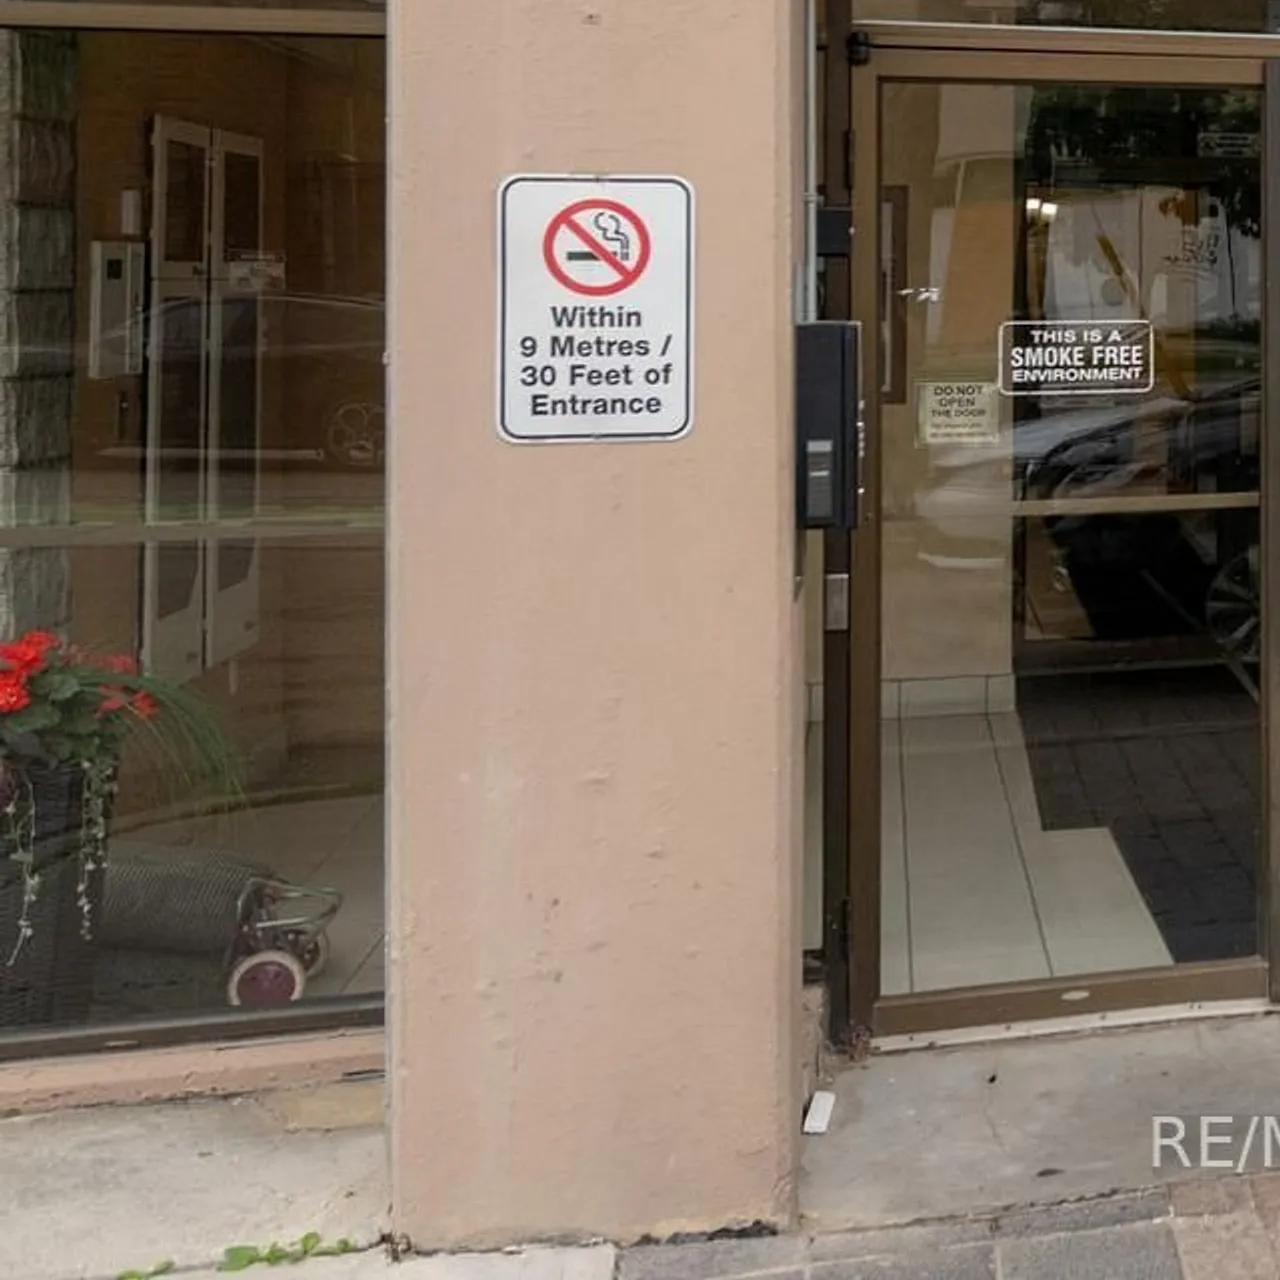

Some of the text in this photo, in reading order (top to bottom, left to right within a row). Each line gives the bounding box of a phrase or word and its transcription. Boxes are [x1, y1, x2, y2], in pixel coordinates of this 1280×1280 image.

[550, 306, 642, 328] Within
[520, 334, 673, 358] 9 Metres /
[1030, 329, 1122, 343] THIS IS A
[1011, 345, 1143, 367] SMOKE FREE
[520, 363, 673, 387] 30 Feet of
[1012, 367, 1143, 383] ENVIRONMENT
[934, 385, 983, 396] DO NOT
[531, 394, 662, 416] Entrance
